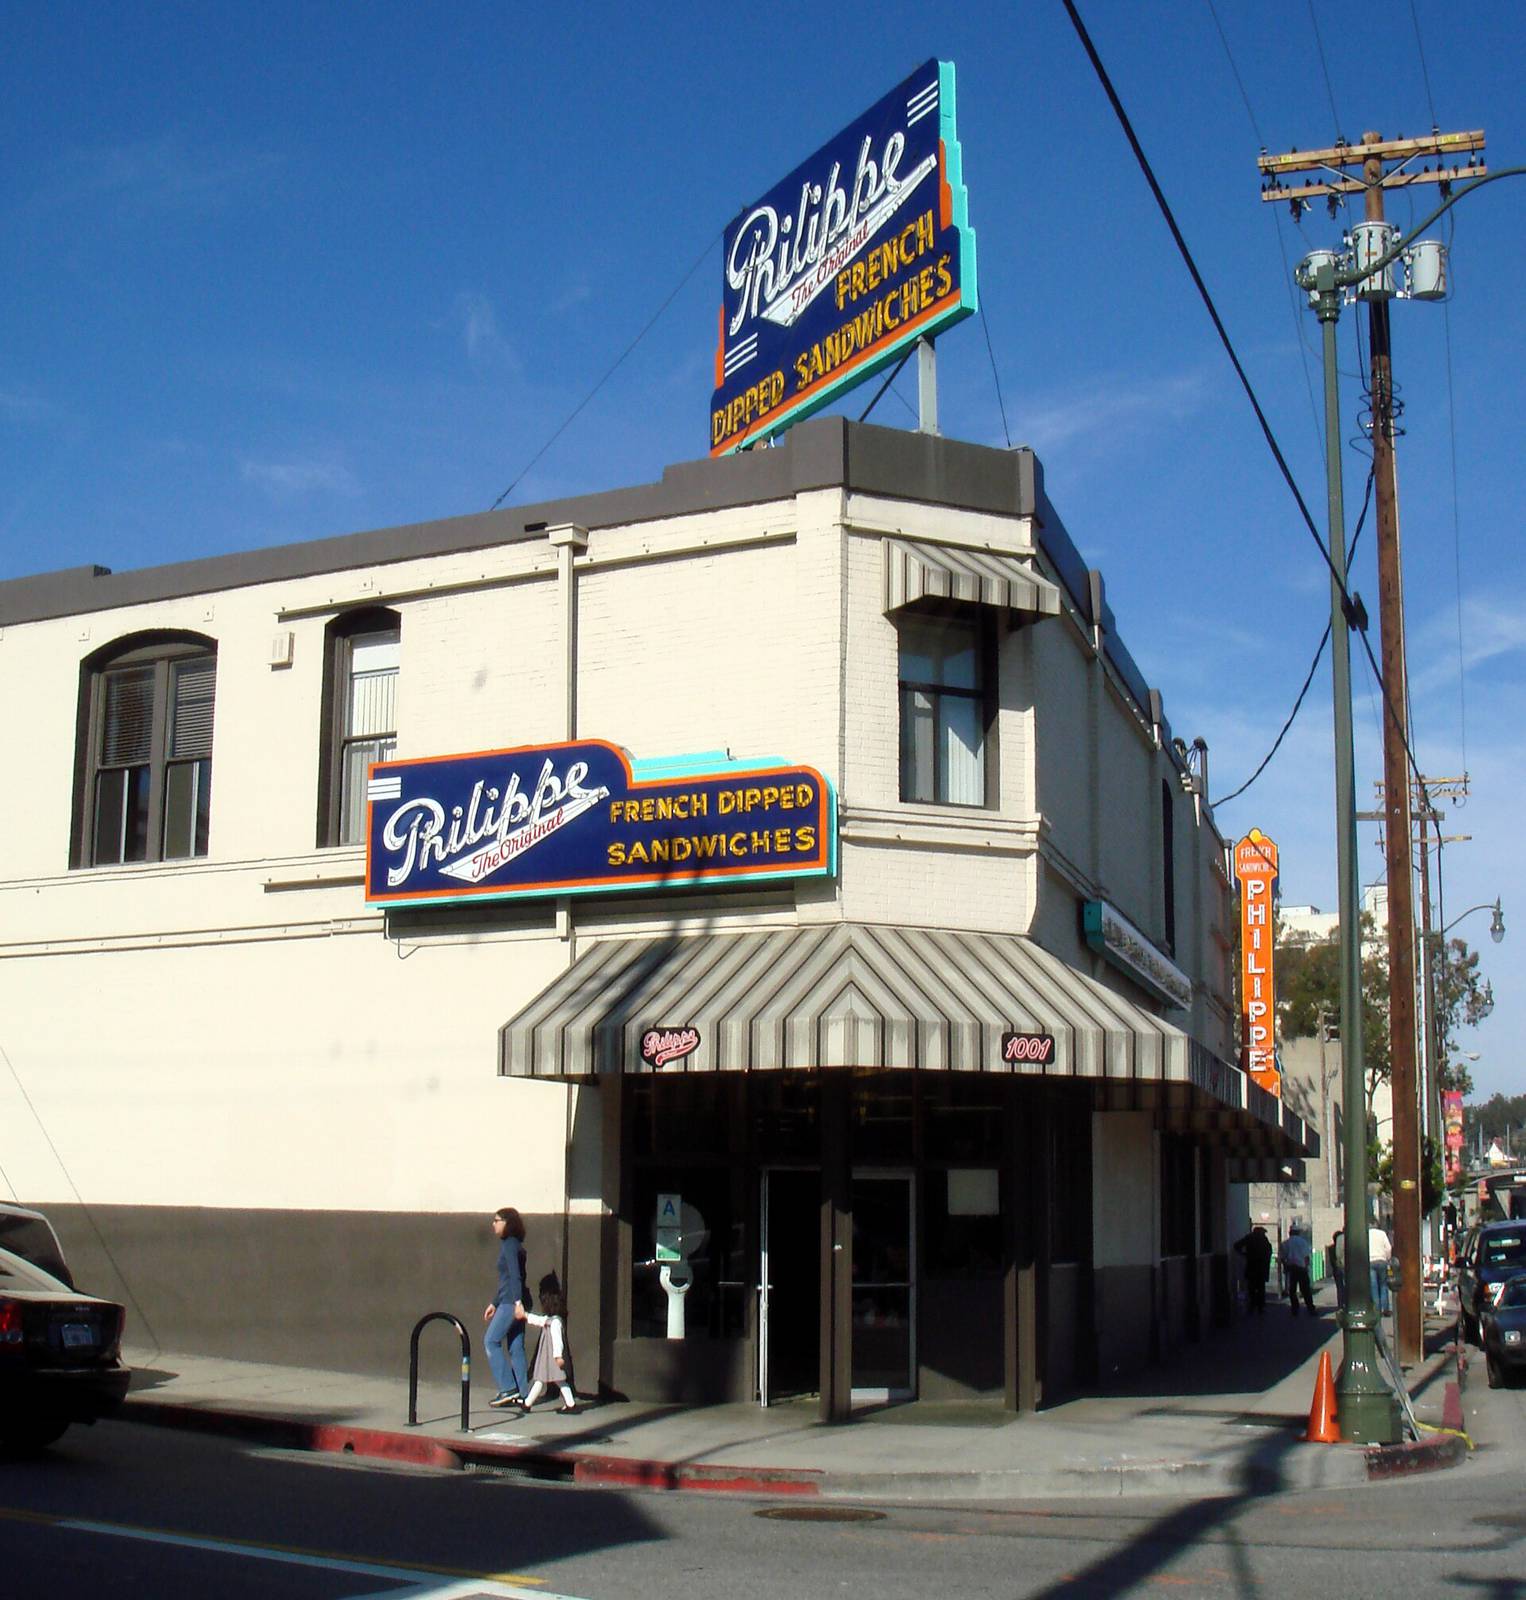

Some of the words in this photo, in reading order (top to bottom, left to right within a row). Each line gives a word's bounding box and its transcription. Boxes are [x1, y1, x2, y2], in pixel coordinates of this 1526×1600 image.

[727, 131, 906, 335] Philippe
[792, 275, 815, 311] The
[817, 220, 869, 285] Original
[836, 209, 935, 311] FRENCH
[712, 371, 785, 445] DIPPED
[795, 254, 953, 390] SANDWICHES
[383, 757, 595, 887] Philippe
[472, 843, 499, 879] The
[500, 807, 564, 861] Original
[607, 825, 815, 867] SANDWICHES
[609, 793, 708, 824] FRENCH
[717, 783, 814, 815] DIPPED
[1247, 879, 1267, 1071] PHILIPPE
[1006, 1037, 1051, 1060] 1001
[663, 1200, 676, 1216] A
